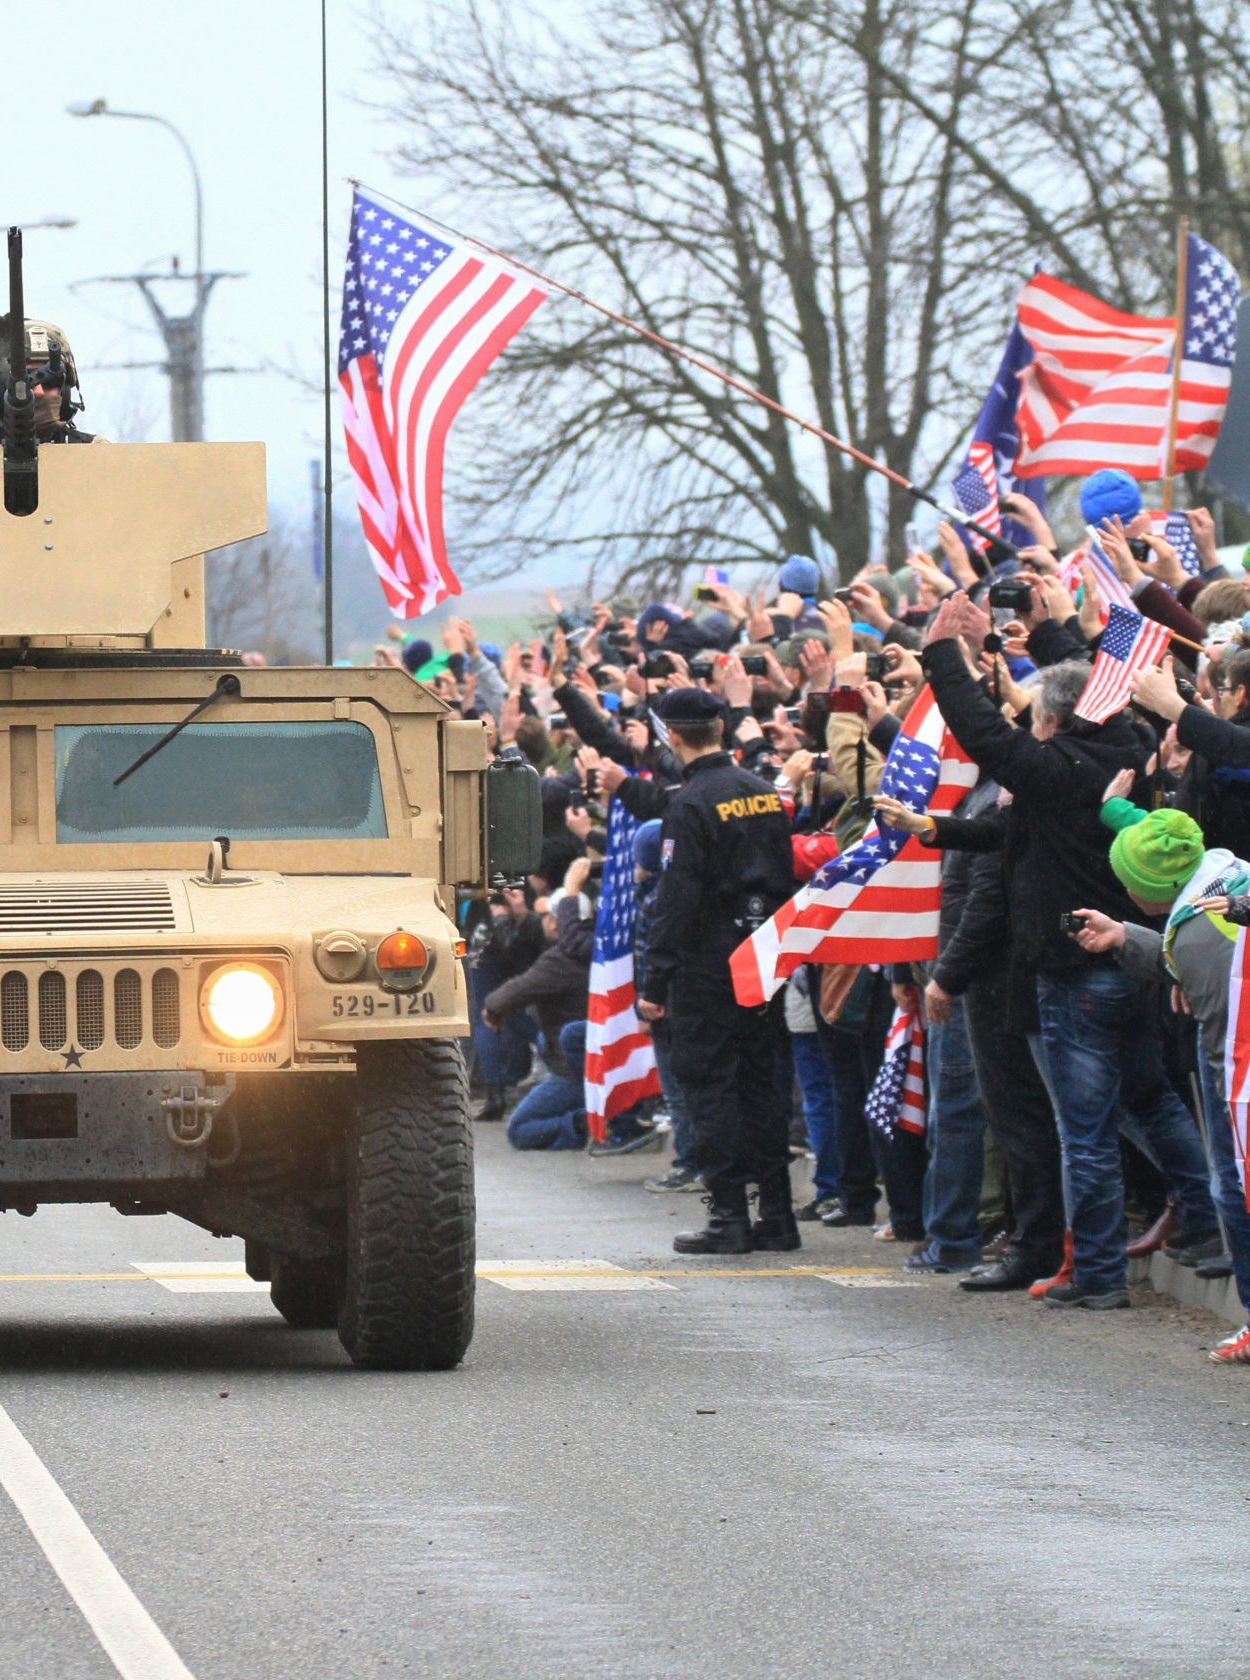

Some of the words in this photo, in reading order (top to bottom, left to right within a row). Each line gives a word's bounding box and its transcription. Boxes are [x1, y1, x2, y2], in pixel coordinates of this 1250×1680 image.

[716, 793, 783, 822] POLICIE
[332, 992, 435, 1017] 529-120
[217, 1052, 277, 1063] TIE-DOWN
